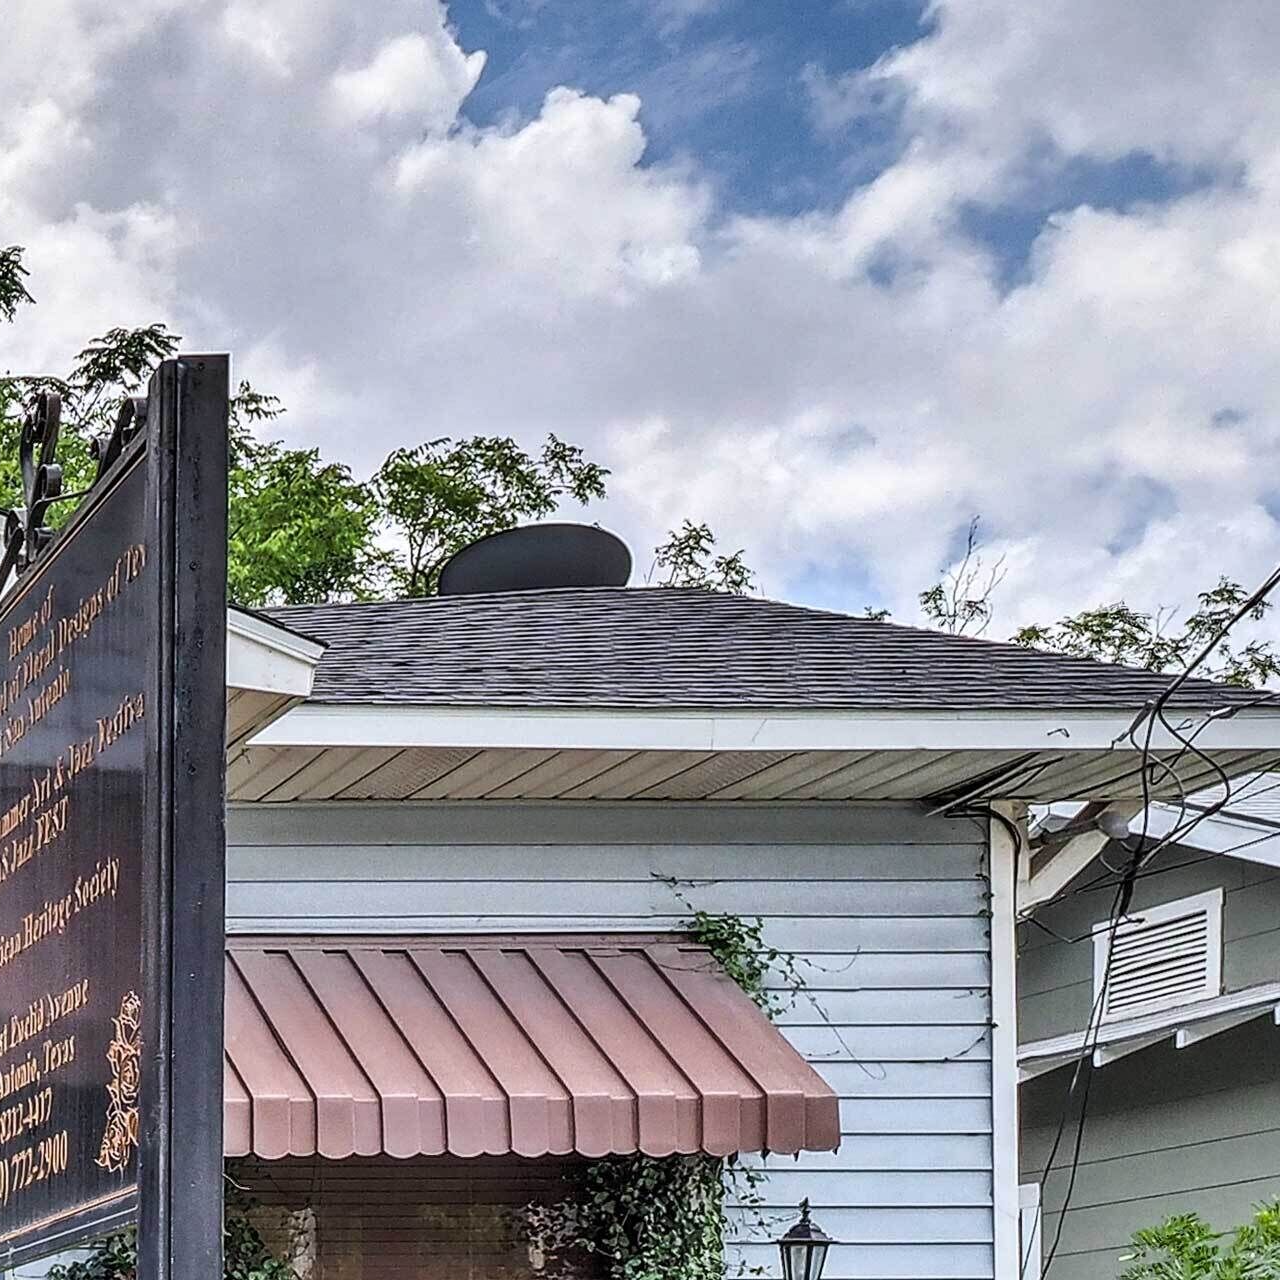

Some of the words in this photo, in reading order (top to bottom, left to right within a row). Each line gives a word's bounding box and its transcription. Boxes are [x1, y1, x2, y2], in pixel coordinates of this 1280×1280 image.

[9, 611, 39, 661] Home
[41, 584, 55, 626] of
[9, 665, 21, 705] of
[23, 629, 56, 689] Floral
[58, 587, 105, 654] Designs
[106, 558, 122, 603] of
[4, 714, 25, 751] San
[28, 665, 71, 726] Antonio
[31, 768, 50, 814] Art
[53, 755, 65, 791] &
[67, 735, 96, 781] Jazz
[10, 833, 34, 874] Jazz
[35, 795, 69, 851] FEST
[22, 893, 72, 950] Heritage
[74, 856, 120, 913] Society
[9, 997, 44, 1049] Euclid
[45, 978, 89, 1028] Avenue
[43, 1035, 76, 1075] Texas
[11, 1129, 69, 1192] 772-2900
